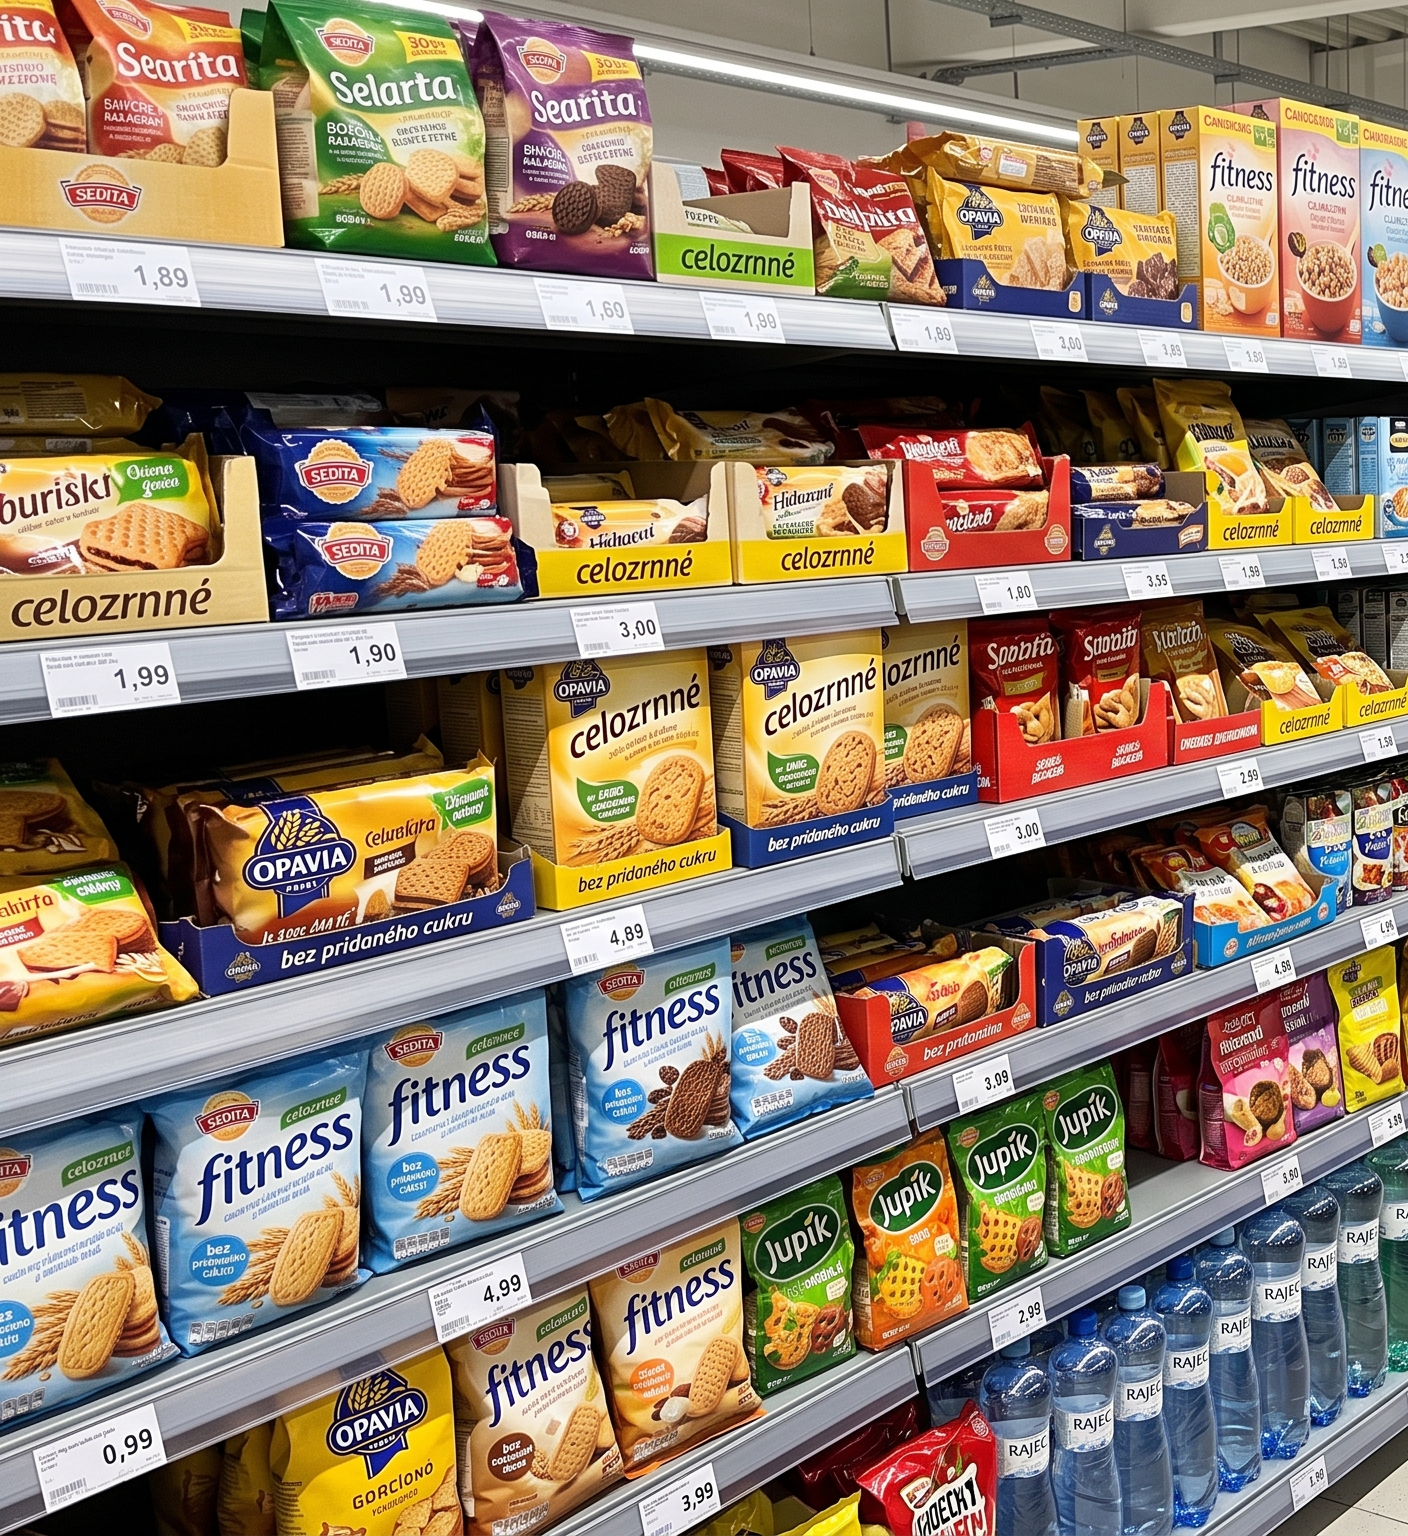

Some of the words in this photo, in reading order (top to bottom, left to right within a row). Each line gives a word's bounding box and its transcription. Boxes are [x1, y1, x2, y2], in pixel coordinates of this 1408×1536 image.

[330, 70, 457, 107] Selarta
[531, 89, 637, 124] Searita
[1209, 152, 1273, 192] fitness
[1291, 154, 1356, 198] fitness
[75, 188, 129, 205] SEDITA
[959, 210, 1001, 225] OPAVIA
[681, 243, 795, 278] celozrnné
[133, 264, 189, 290] 1,89
[379, 283, 427, 307] 1,99
[310, 468, 359, 484] SEDITA
[332, 544, 379, 559] SEDITA
[781, 540, 875, 571] celozrnné
[576, 550, 693, 585] celozrnné
[11, 578, 212, 628] celozrnné
[1007, 585, 1031, 601] 1,80
[619, 619, 656, 640] 3,00
[349, 643, 396, 666] 1,90
[883, 636, 960, 690] lozrnné
[114, 665, 169, 691] 1,99
[754, 663, 797, 681] OPAVIA
[558, 680, 606, 698] OPAVIA
[764, 658, 877, 737] celozrnné
[570, 674, 701, 759] celozrnné
[943, 783, 969, 800] cukru
[767, 834, 786, 852] bez
[789, 822, 850, 850] pridaného
[852, 815, 881, 836] cukru
[252, 847, 349, 880] OPAVIA
[578, 873, 603, 893] bez
[606, 857, 676, 890] pridaného
[679, 847, 716, 869] cukru
[281, 945, 317, 970] bez
[322, 922, 419, 966] pridaného
[423, 911, 473, 938] cukru
[609, 924, 644, 947] 4,89
[731, 951, 818, 1012] itness
[603, 984, 720, 1073] fitness
[394, 1037, 435, 1057] SEDITA
[387, 1044, 531, 1147] fitness
[206, 1108, 250, 1130] SEDITA
[1059, 1095, 1112, 1147] Jupík
[196, 1113, 354, 1227] fitness
[973, 1129, 1033, 1185] Jupík
[876, 1168, 937, 1224] Jupík
[0, 1168, 139, 1267] itness
[206, 1243, 230, 1257] bez
[768, 1214, 832, 1275] Jupík
[1307, 1256, 1336, 1278] RAJE
[483, 1274, 522, 1303] 4,99
[1264, 1282, 1300, 1305] RAJEC
[624, 1259, 735, 1355] fitness
[1018, 1302, 1041, 1325] 2.99
[1220, 1317, 1250, 1340] RAJE
[1173, 1350, 1208, 1375] RAJEC
[1126, 1378, 1162, 1405] RAJEC
[336, 1395, 419, 1446] OPAVIA
[1073, 1408, 1111, 1433] RAJEC
[103, 1429, 153, 1465] 0,99
[1008, 1432, 1048, 1462] RAJEC
[681, 1481, 714, 1511] 3,99
